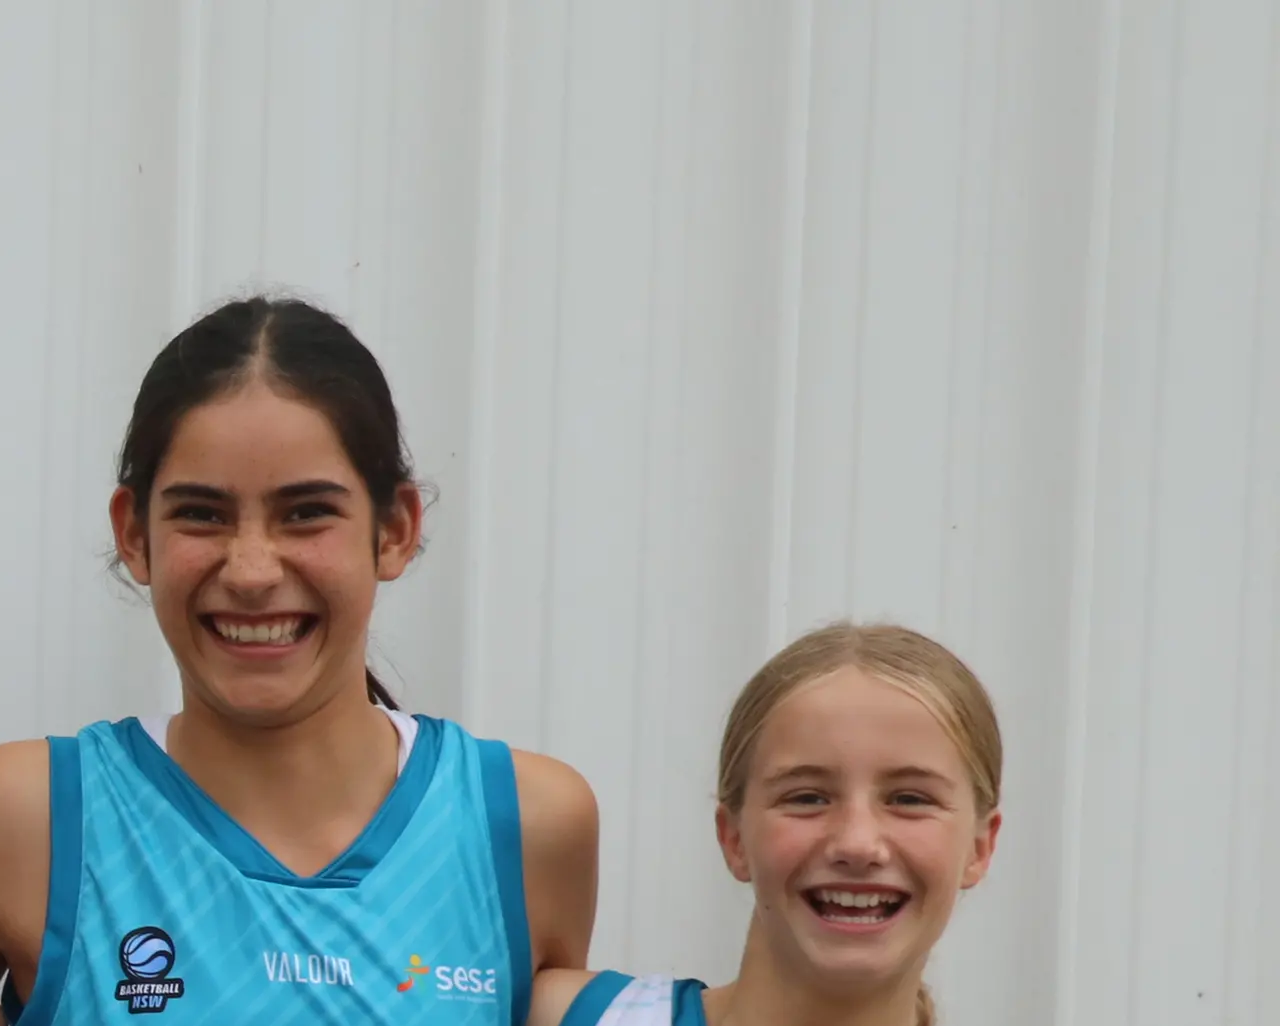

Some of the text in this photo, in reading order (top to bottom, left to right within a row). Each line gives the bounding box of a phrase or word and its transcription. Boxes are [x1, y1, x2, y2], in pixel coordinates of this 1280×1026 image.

[263, 951, 354, 986] VALOUR
[119, 983, 180, 996] BASKETBALL
[132, 995, 164, 1009] NSW
